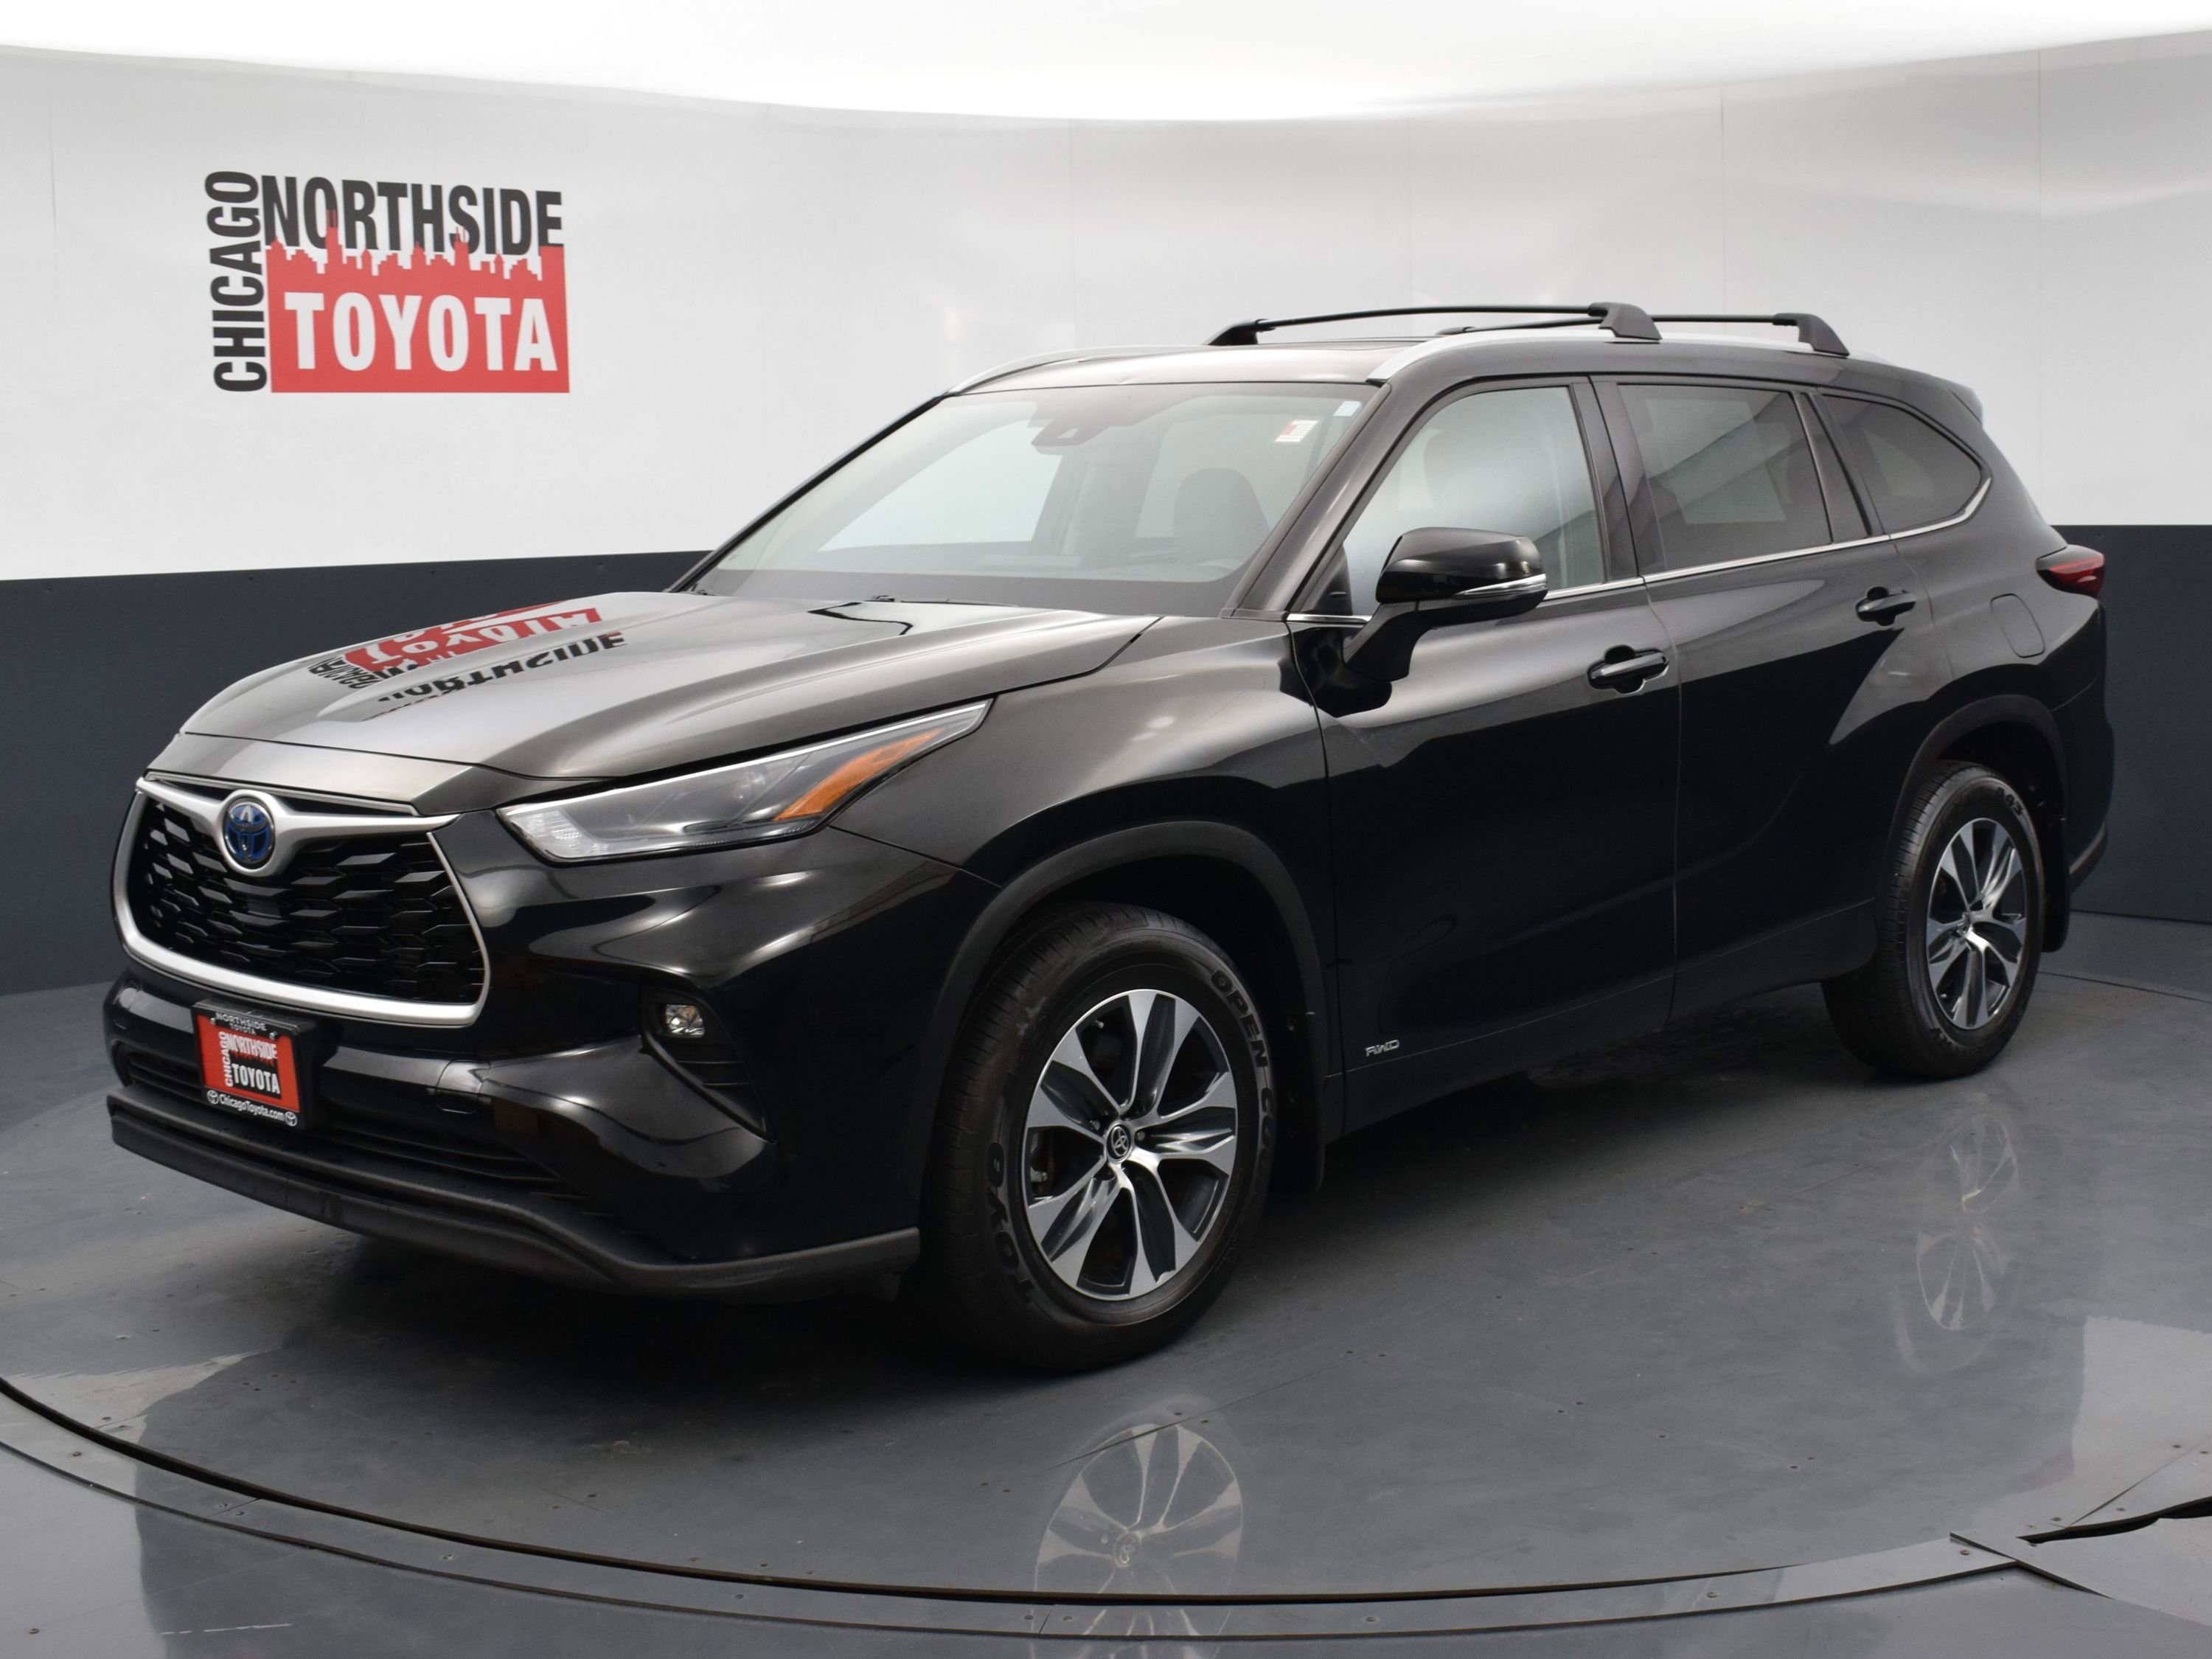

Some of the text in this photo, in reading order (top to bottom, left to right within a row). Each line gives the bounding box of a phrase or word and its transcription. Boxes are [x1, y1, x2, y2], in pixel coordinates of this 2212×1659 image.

[261, 175, 564, 256] NORTHSIDE
[205, 171, 267, 392] CHICAGO
[284, 292, 557, 372] TOYOTA
[215, 1012, 268, 1032] NORTHSIDE
[229, 1023, 257, 1035] TOYOTA
[1210, 969, 1270, 1069] OPEN
[218, 1031, 234, 1088] CHICAGO
[226, 1033, 278, 1060] NORTHSIDE
[1366, 1039, 1400, 1057] AWD
[232, 1062, 281, 1095] TOYOTA
[219, 1093, 285, 1122] ChicagoToyota.com
[987, 1141, 1035, 1304] TOYO
